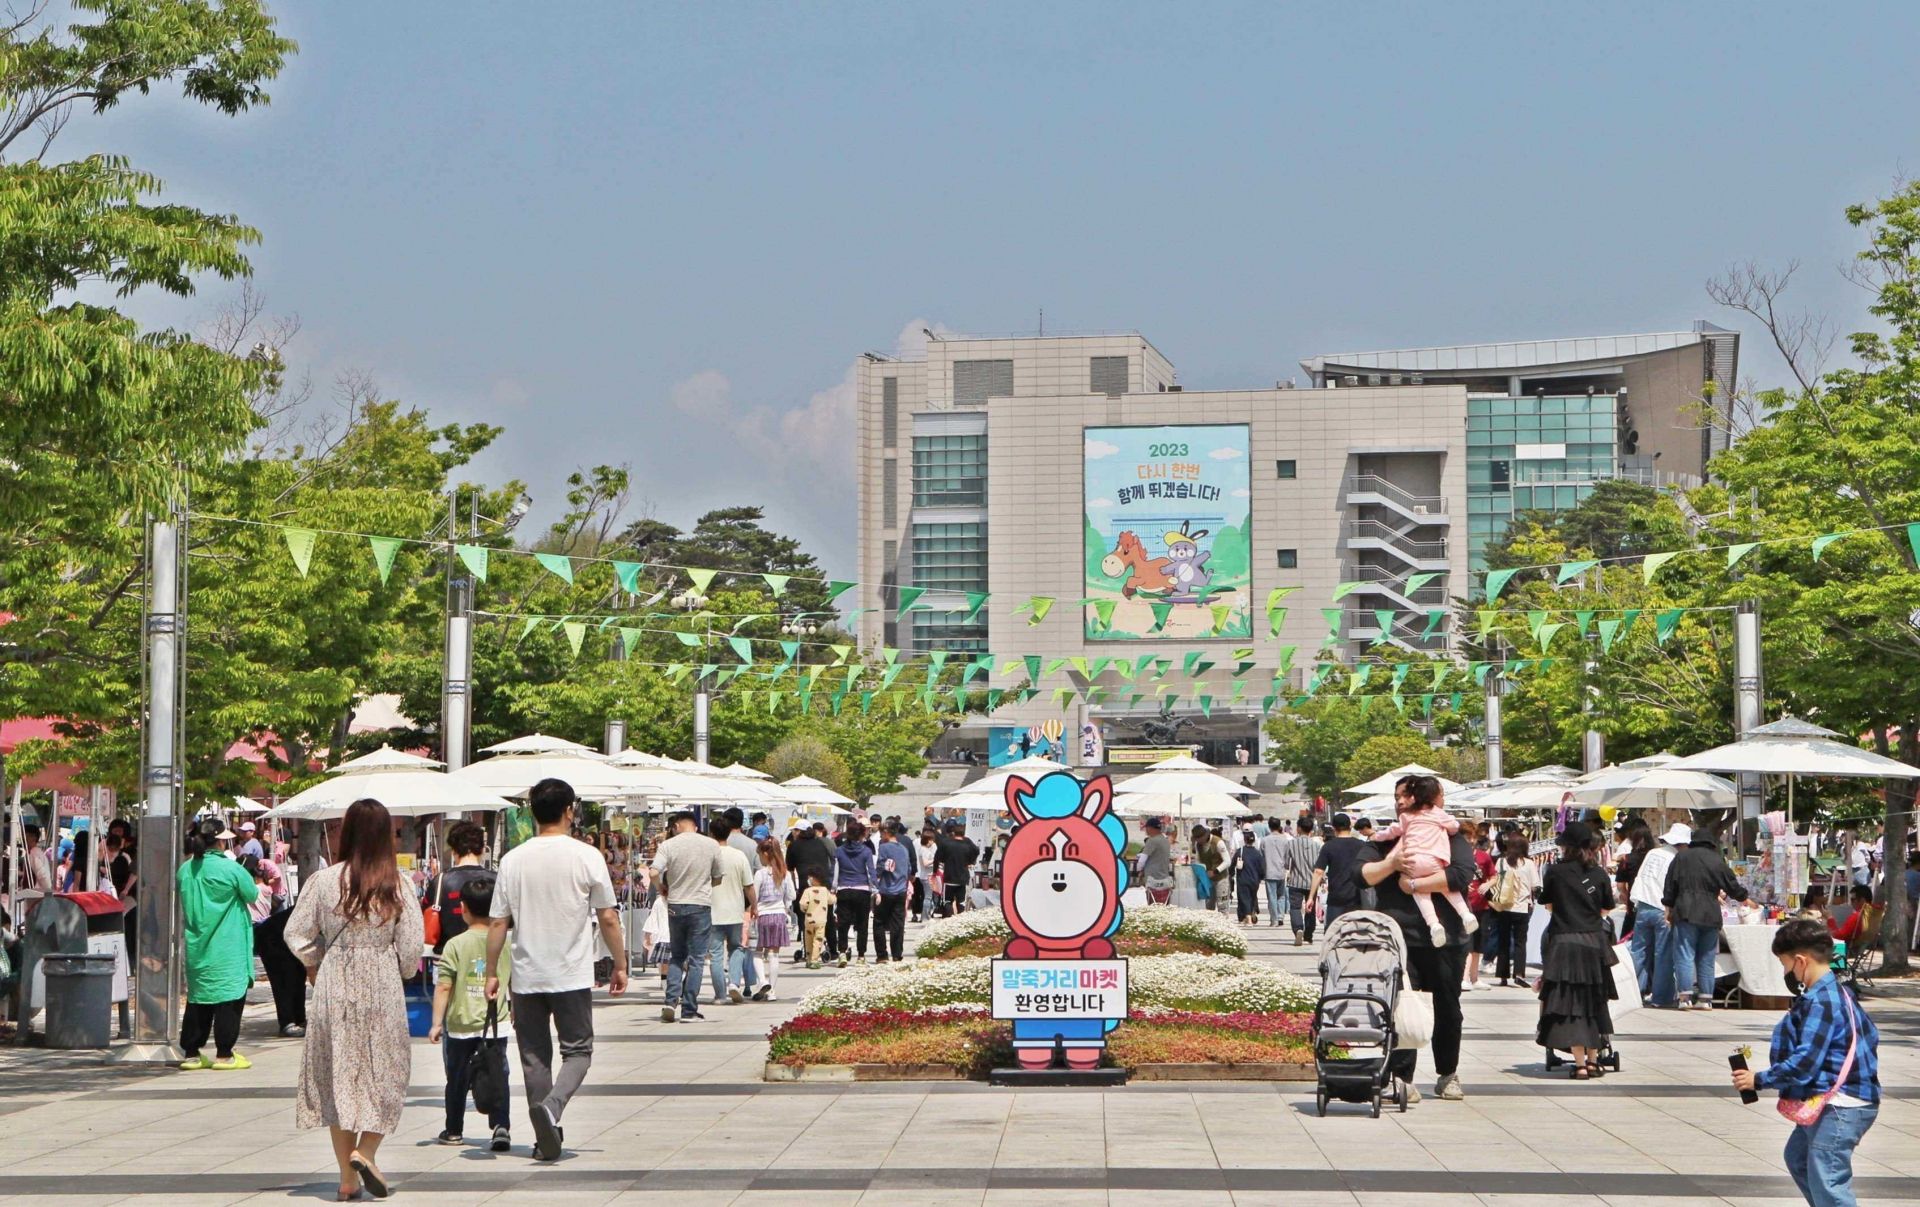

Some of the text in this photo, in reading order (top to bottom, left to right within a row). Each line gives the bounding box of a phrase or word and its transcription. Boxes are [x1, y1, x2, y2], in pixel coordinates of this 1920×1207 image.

[1148, 443, 1189, 458] 2023
[1137, 462, 1200, 481] 다시 한번
[1117, 482, 1221, 505] 함께 뛰겠습니다!
[971, 812, 985, 820] TAKE
[1002, 969, 1118, 989] 말죽거리마켓
[1014, 993, 1105, 1013] 환영합니다
